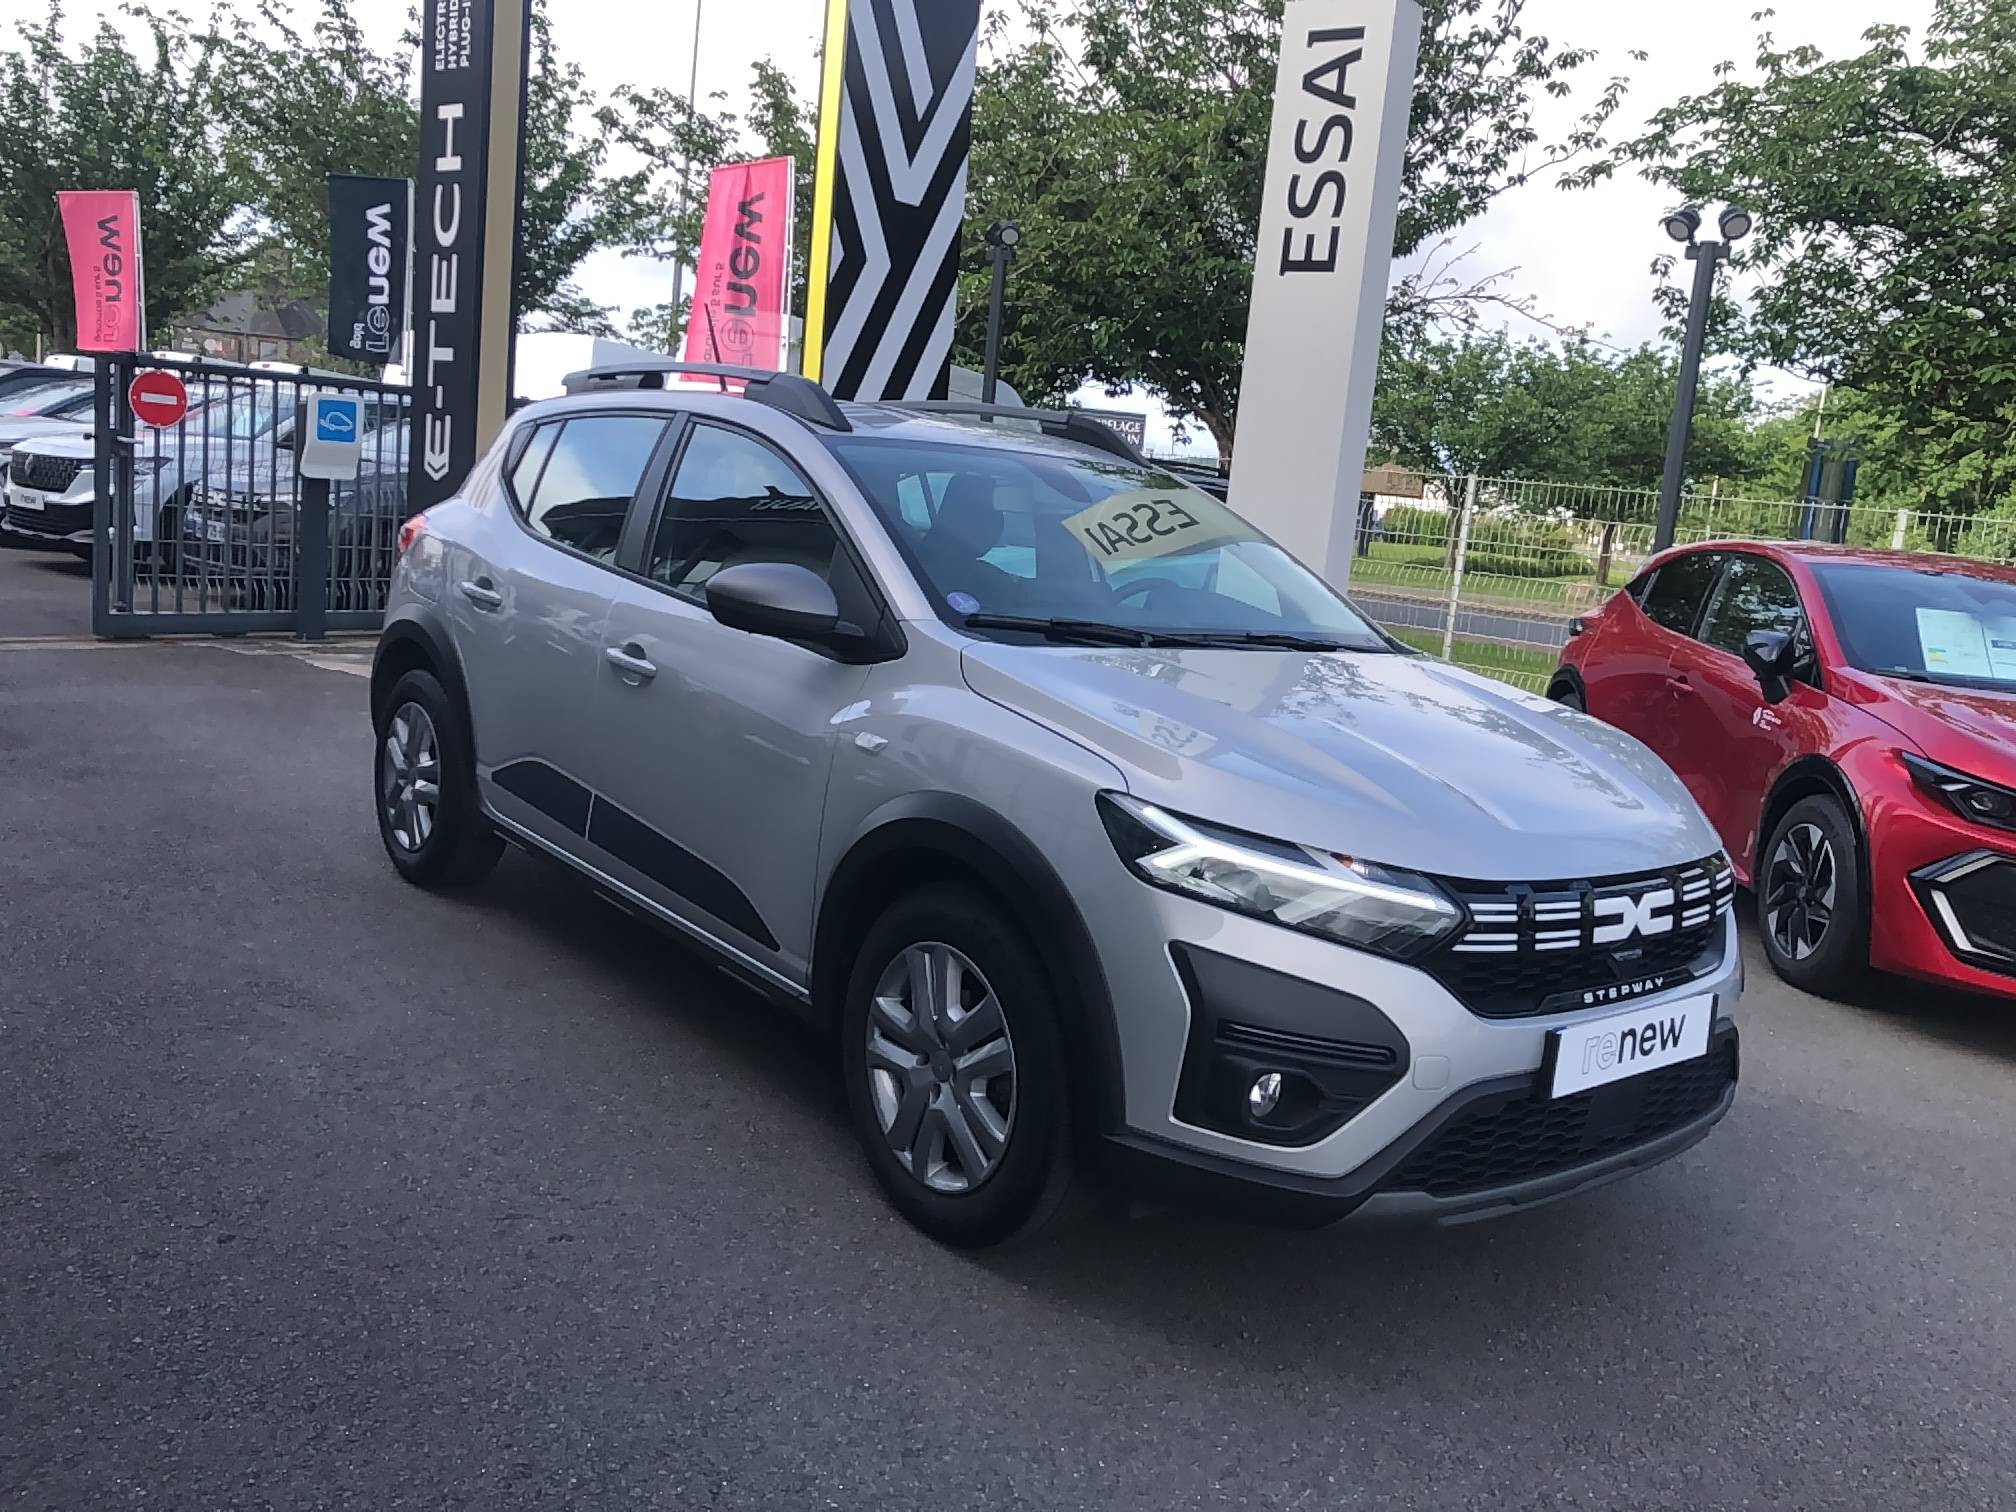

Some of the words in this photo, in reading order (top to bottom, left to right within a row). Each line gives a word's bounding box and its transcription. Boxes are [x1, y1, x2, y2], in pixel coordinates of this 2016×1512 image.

[435, 0, 447, 71] ELECTR
[448, 0, 459, 69] HYBRID
[460, 0, 472, 67] PLUG-I
[1279, 26, 1366, 276] ESSAI
[424, 103, 464, 481] E-TECH
[1583, 976, 1664, 1004] STEPWAY
[1582, 1014, 1687, 1075] renew
